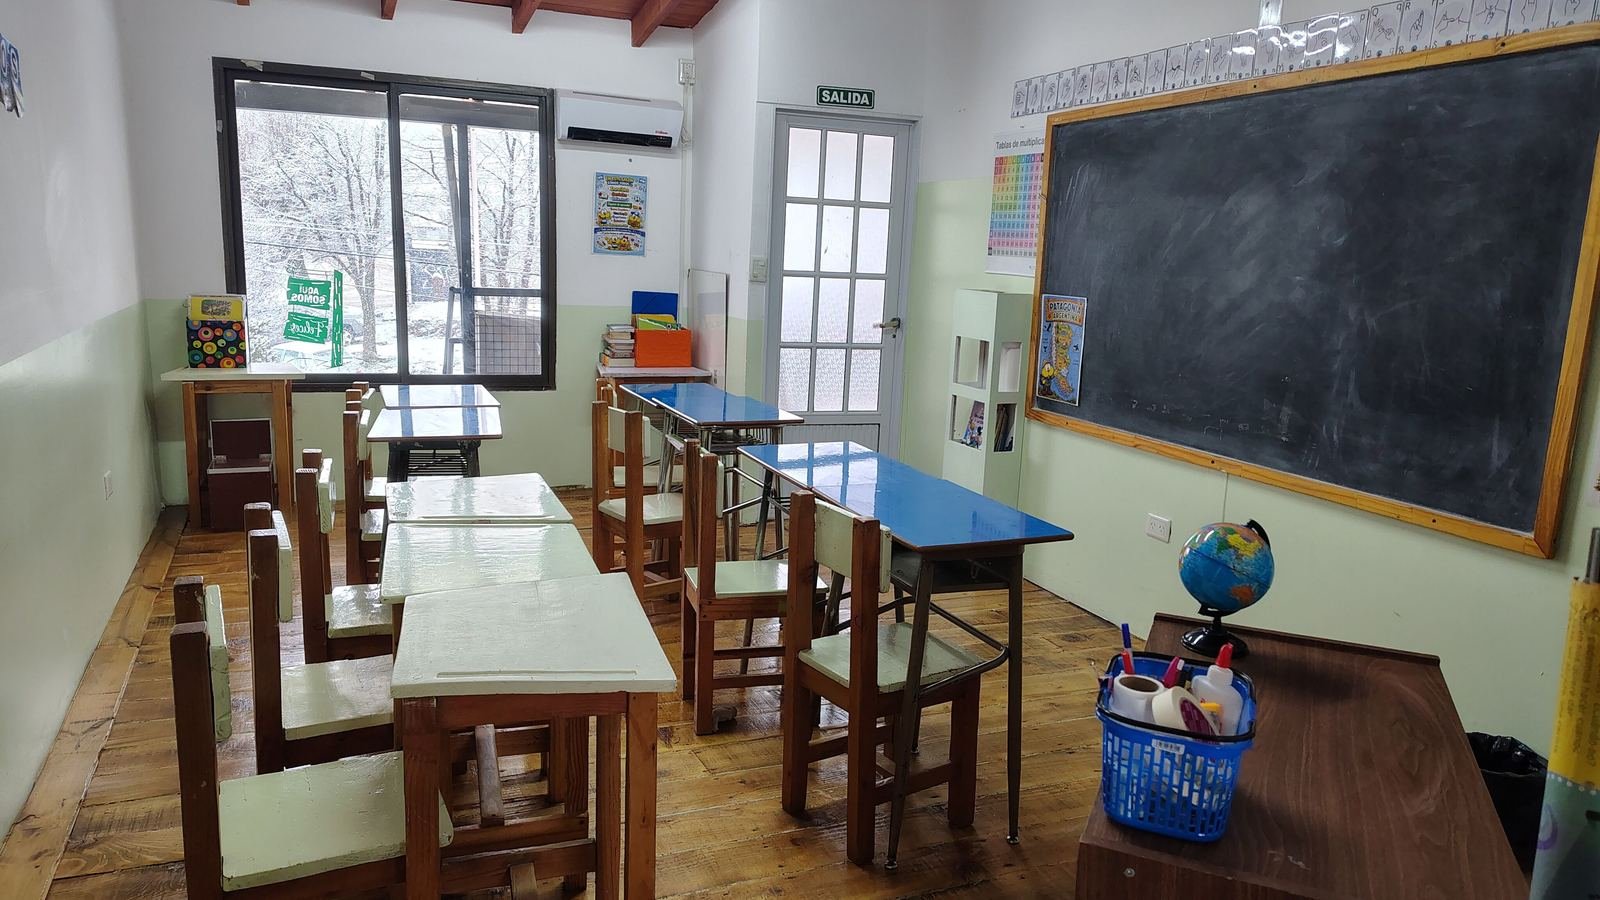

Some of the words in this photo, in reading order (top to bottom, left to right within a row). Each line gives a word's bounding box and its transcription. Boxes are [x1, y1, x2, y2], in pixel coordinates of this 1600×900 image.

[822, 90, 870, 105] SALIDA
[996, 140, 1011, 150] Tablas
[1012, 140, 1019, 148] de
[1049, 302, 1081, 313] PATAGONIA
